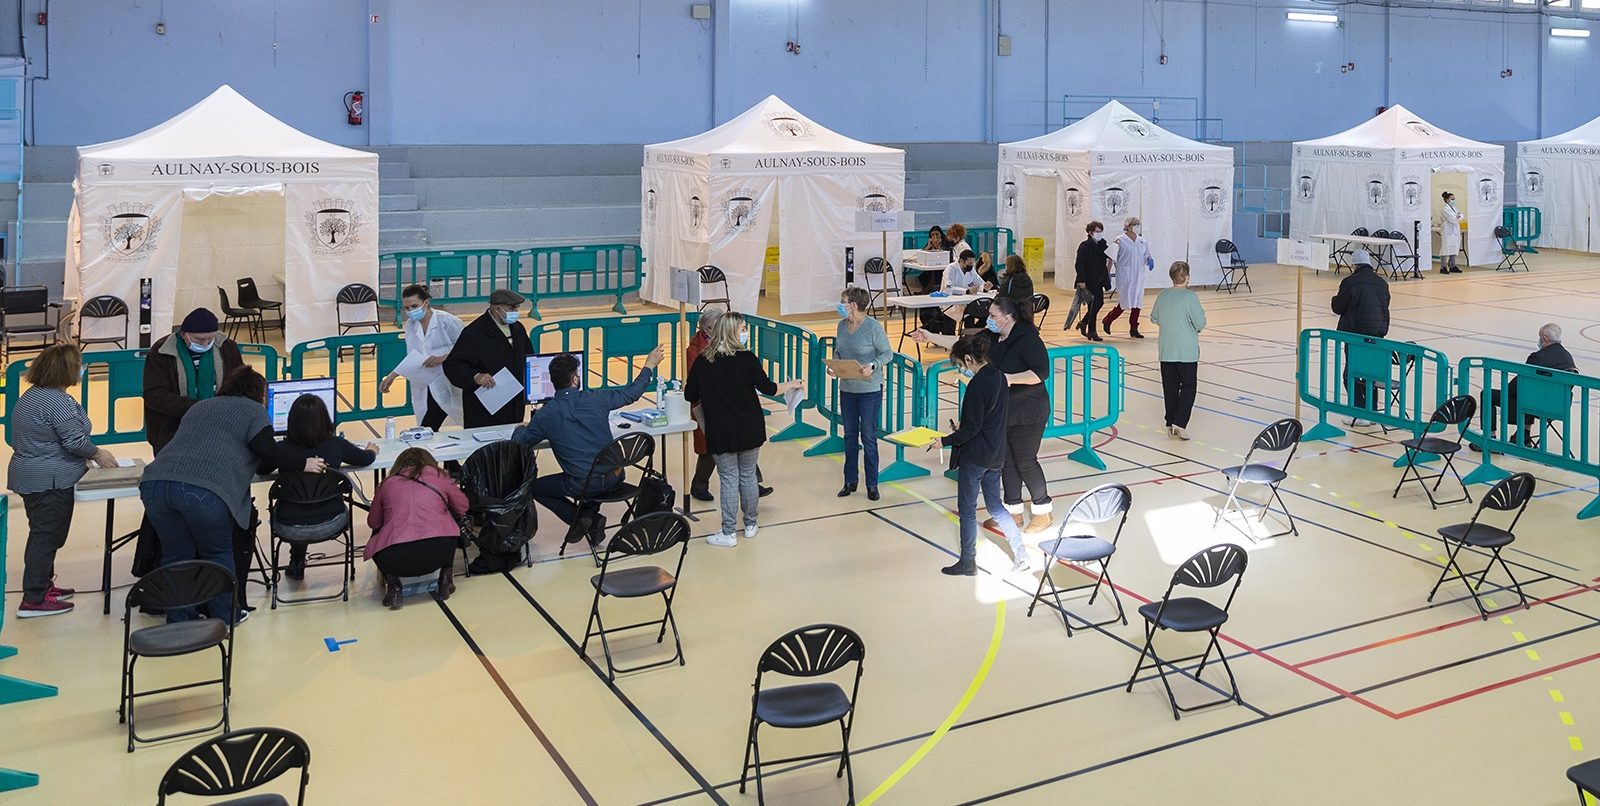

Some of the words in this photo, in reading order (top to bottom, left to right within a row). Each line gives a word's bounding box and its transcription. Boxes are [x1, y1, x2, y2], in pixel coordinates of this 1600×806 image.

[1313, 149, 1372, 159] AULNAY-SOUS-BOIS
[1419, 151, 1483, 160] AULNAY-SOUS-BOIS
[1540, 147, 1600, 156] AULNAY-SOUS-BO
[1016, 151, 1069, 163] AULNAY-SOUS-BOIS
[1122, 154, 1205, 164] AULNAY-SOUS-BOIS
[755, 157, 867, 168] AULNAY-SOUS-BOIS
[151, 162, 320, 175] AULNAY-SOUS-BOIS
